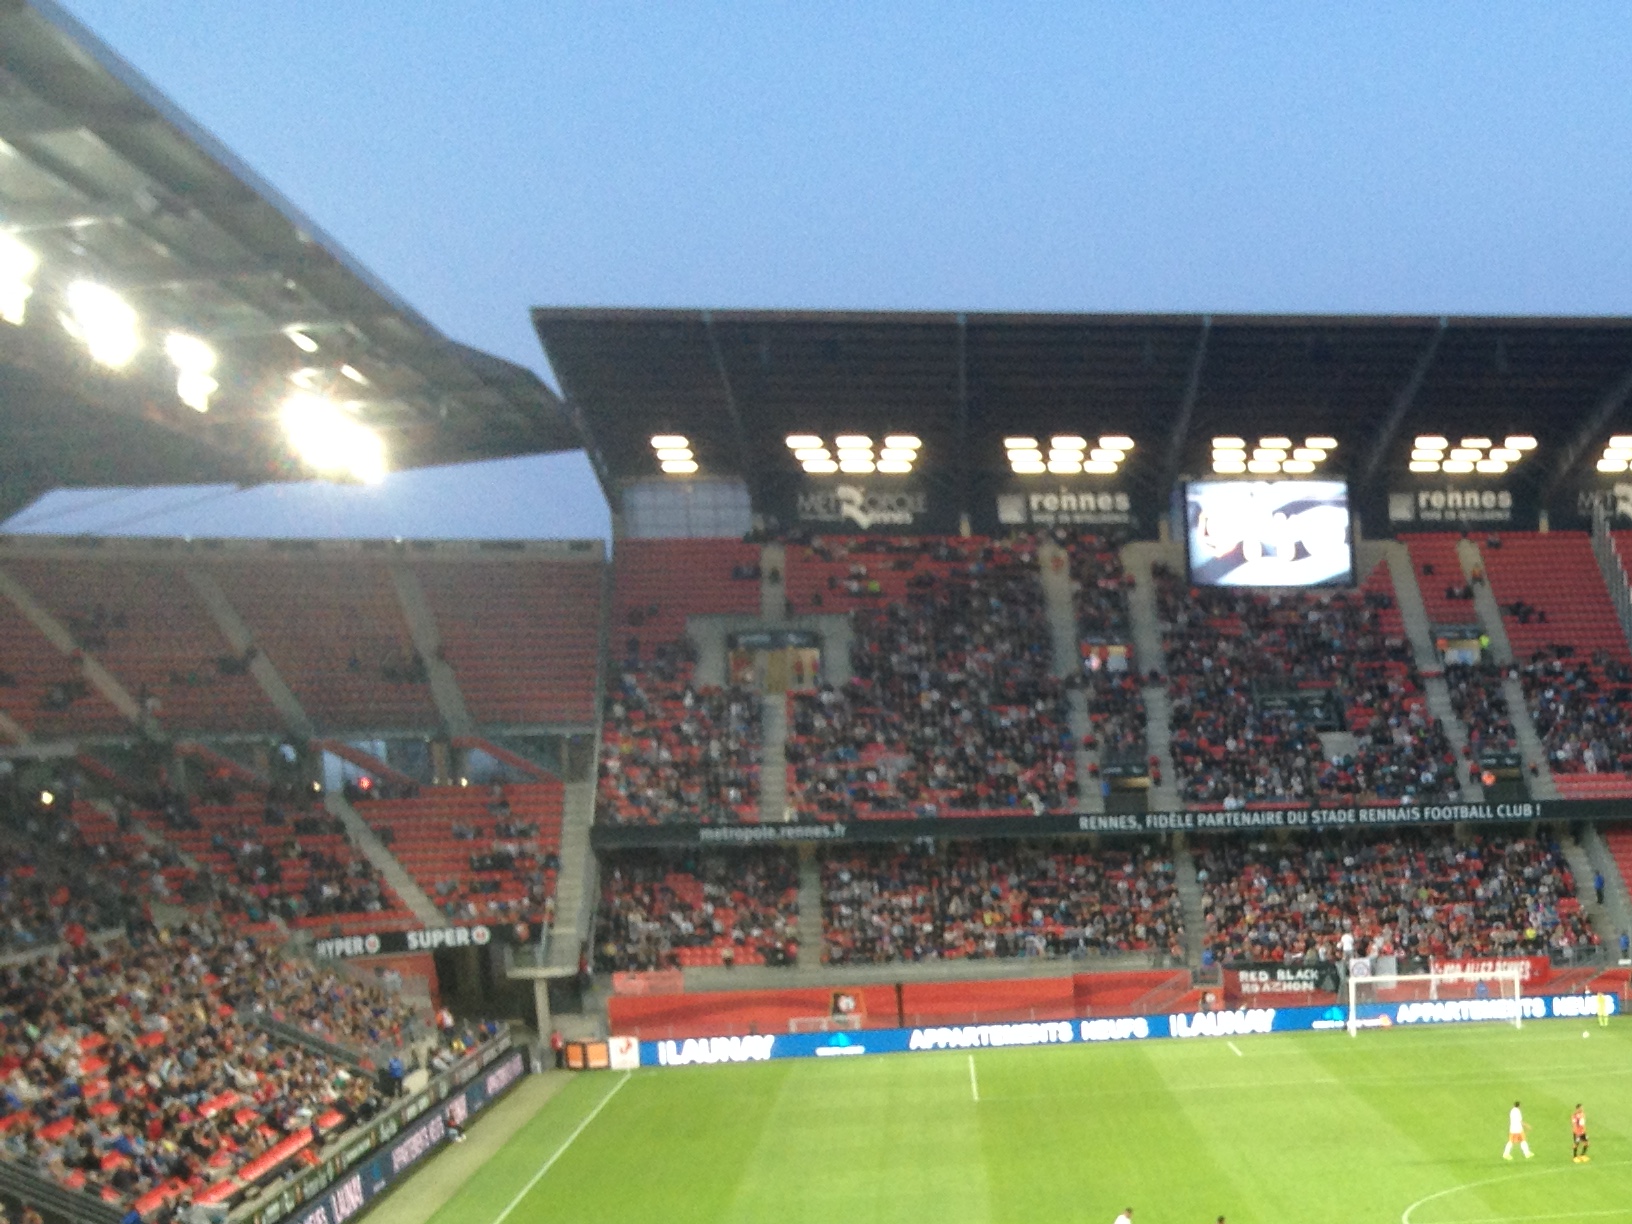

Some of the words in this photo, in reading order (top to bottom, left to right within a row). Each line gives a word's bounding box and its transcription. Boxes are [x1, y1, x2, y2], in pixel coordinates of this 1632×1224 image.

[1079, 815, 1143, 831] RENNES,
[1198, 810, 1284, 827] PARTENAIRE
[1287, 811, 1308, 824] DU
[1312, 808, 1355, 824] STADE
[1359, 806, 1420, 822] RENNAIS
[1424, 804, 1494, 820] FOOTBALL
[1497, 803, 1533, 818] CLUB
[407, 927, 470, 950] SUPER
[1277, 968, 1319, 981] BLACK
[909, 1021, 1074, 1050] APPARTEMENTS
[1081, 1017, 1148, 1041] NEUFS
